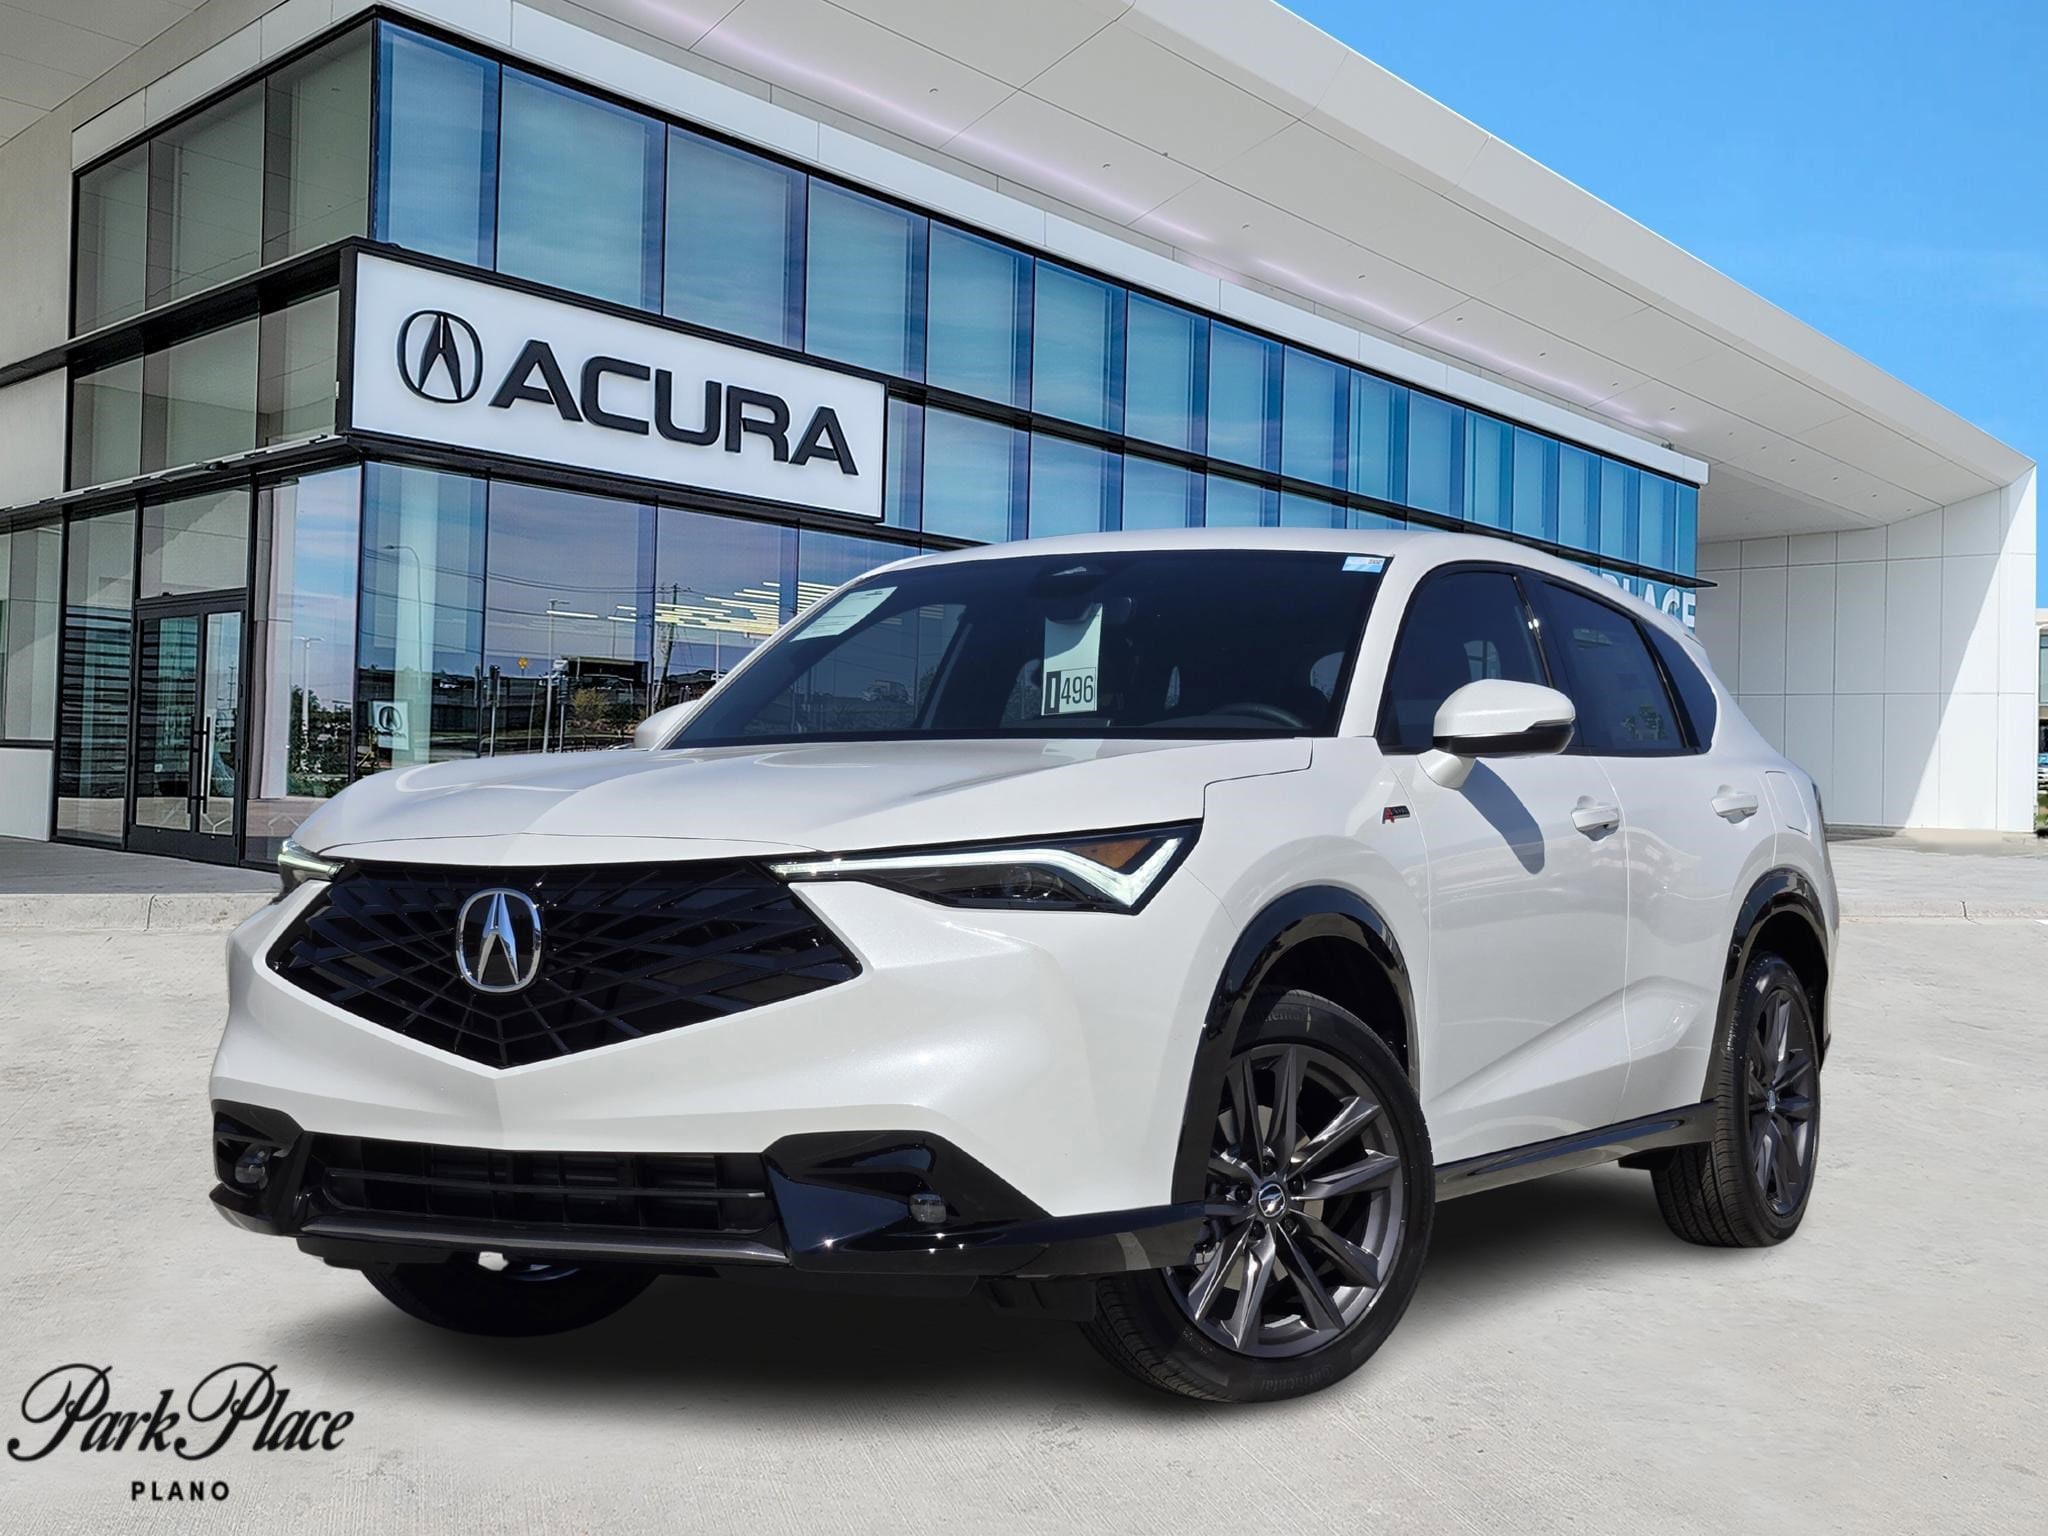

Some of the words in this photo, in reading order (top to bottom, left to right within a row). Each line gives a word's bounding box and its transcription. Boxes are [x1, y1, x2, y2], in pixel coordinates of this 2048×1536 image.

[488, 340, 859, 476] ACURA
[1601, 573, 1697, 633] ACE
[1060, 675, 1094, 705] 496
